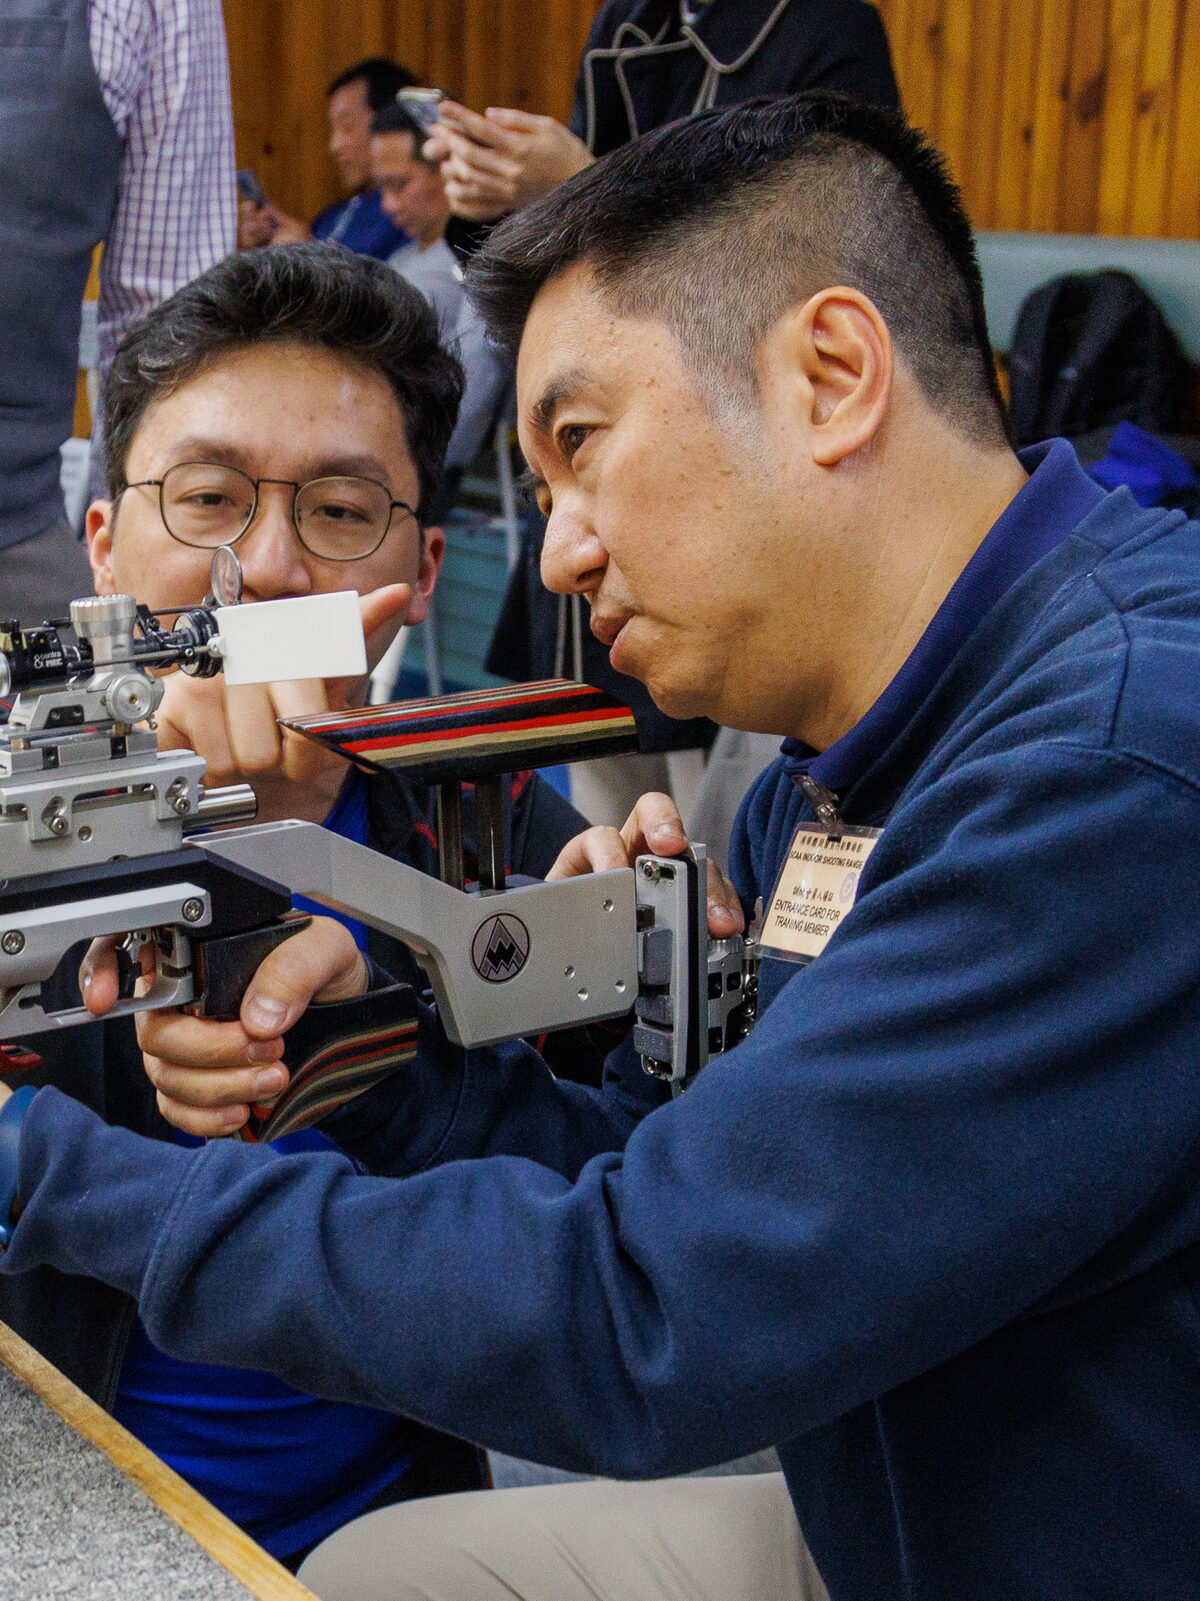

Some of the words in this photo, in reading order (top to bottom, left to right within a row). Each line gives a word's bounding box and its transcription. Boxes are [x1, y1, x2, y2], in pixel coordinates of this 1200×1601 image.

[790, 851, 802, 861] SCAA
[822, 855, 846, 868] SHOOTING
[845, 858, 864, 869] RANGE
[774, 899, 809, 916] ENTRANCE
[809, 906, 827, 919] CARD
[826, 908, 841, 922] FOR
[803, 921, 830, 936] MEMBER
